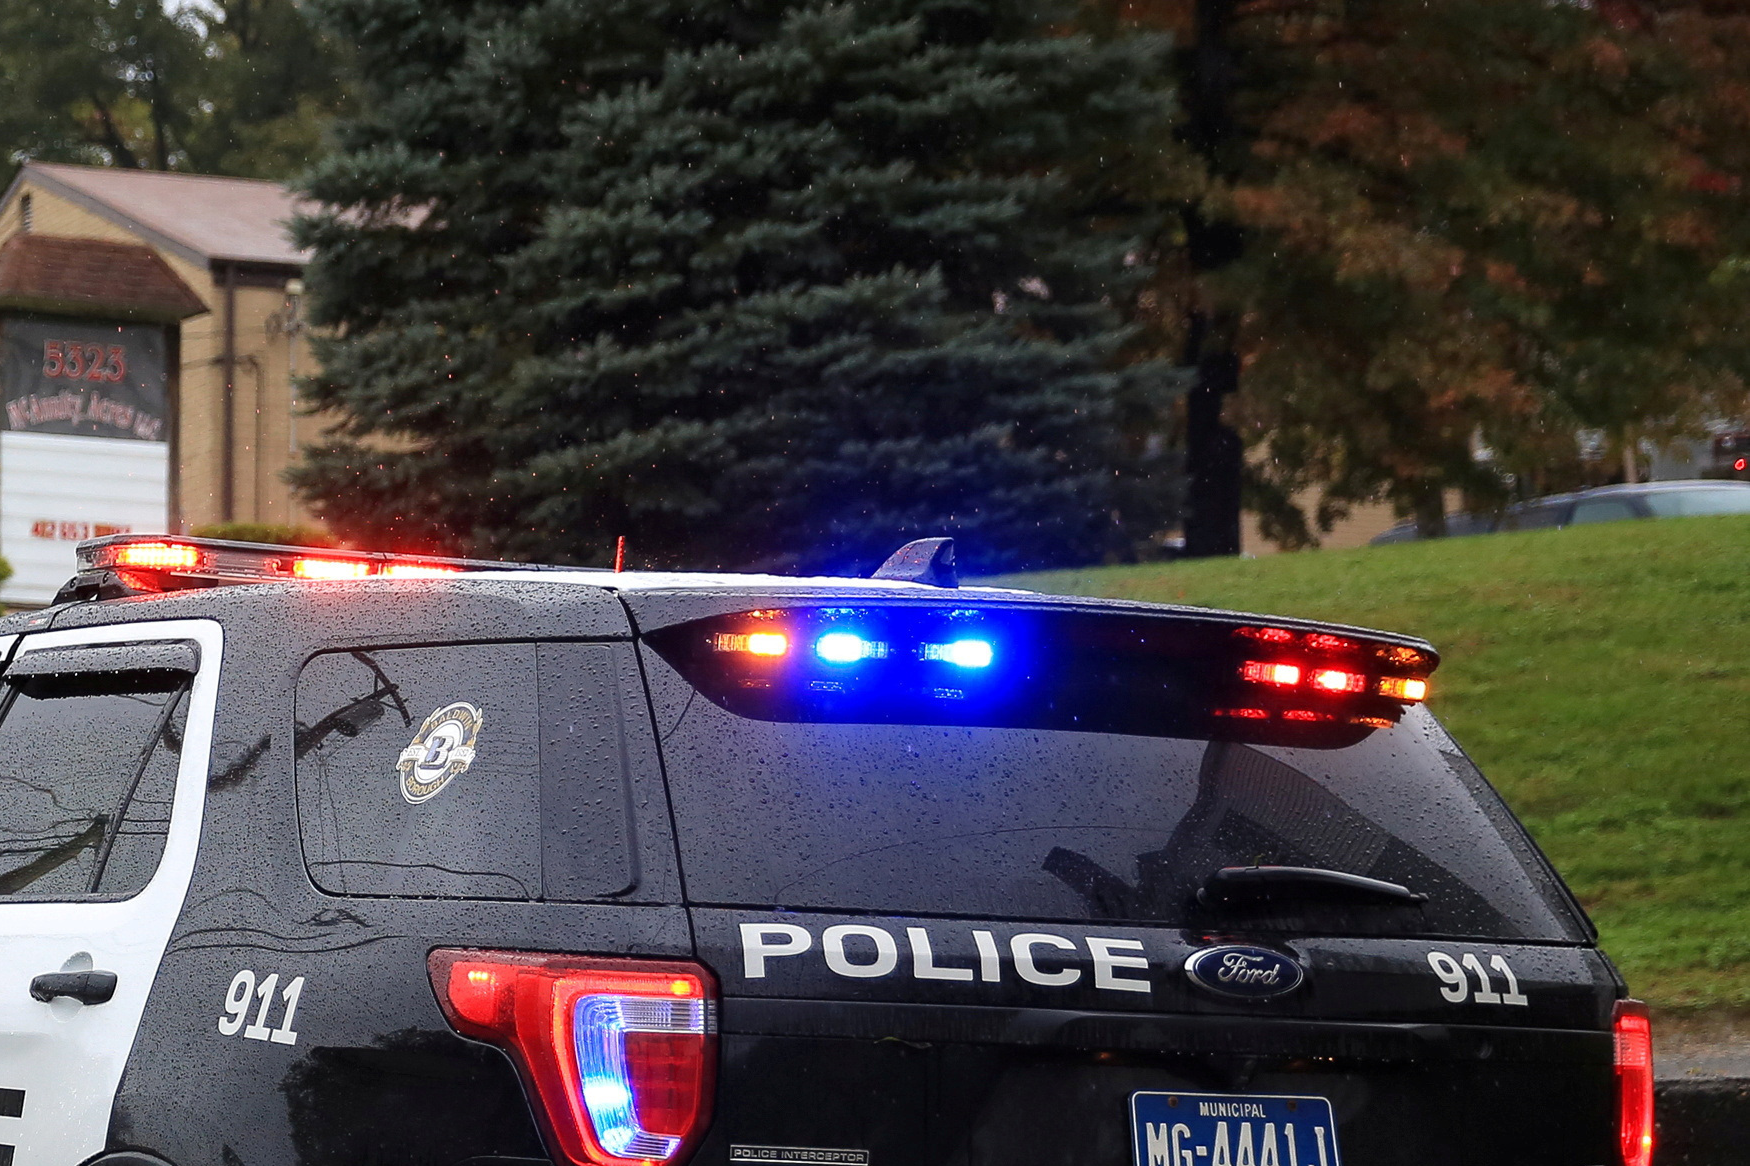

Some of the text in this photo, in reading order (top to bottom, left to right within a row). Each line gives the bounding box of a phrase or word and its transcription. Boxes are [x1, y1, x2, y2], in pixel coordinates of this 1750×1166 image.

[43, 339, 125, 382] 5323
[430, 709, 473, 730] BALDWIN
[406, 776, 445, 795] BOROUGH
[739, 922, 1151, 993] POLICE
[1217, 952, 1281, 986] Ford
[1427, 951, 1529, 1007] 911
[218, 969, 305, 1046] 911
[1199, 1102, 1266, 1118] MUNICIPAL
[734, 1149, 864, 1162] POLICE INTERCEPTOR
